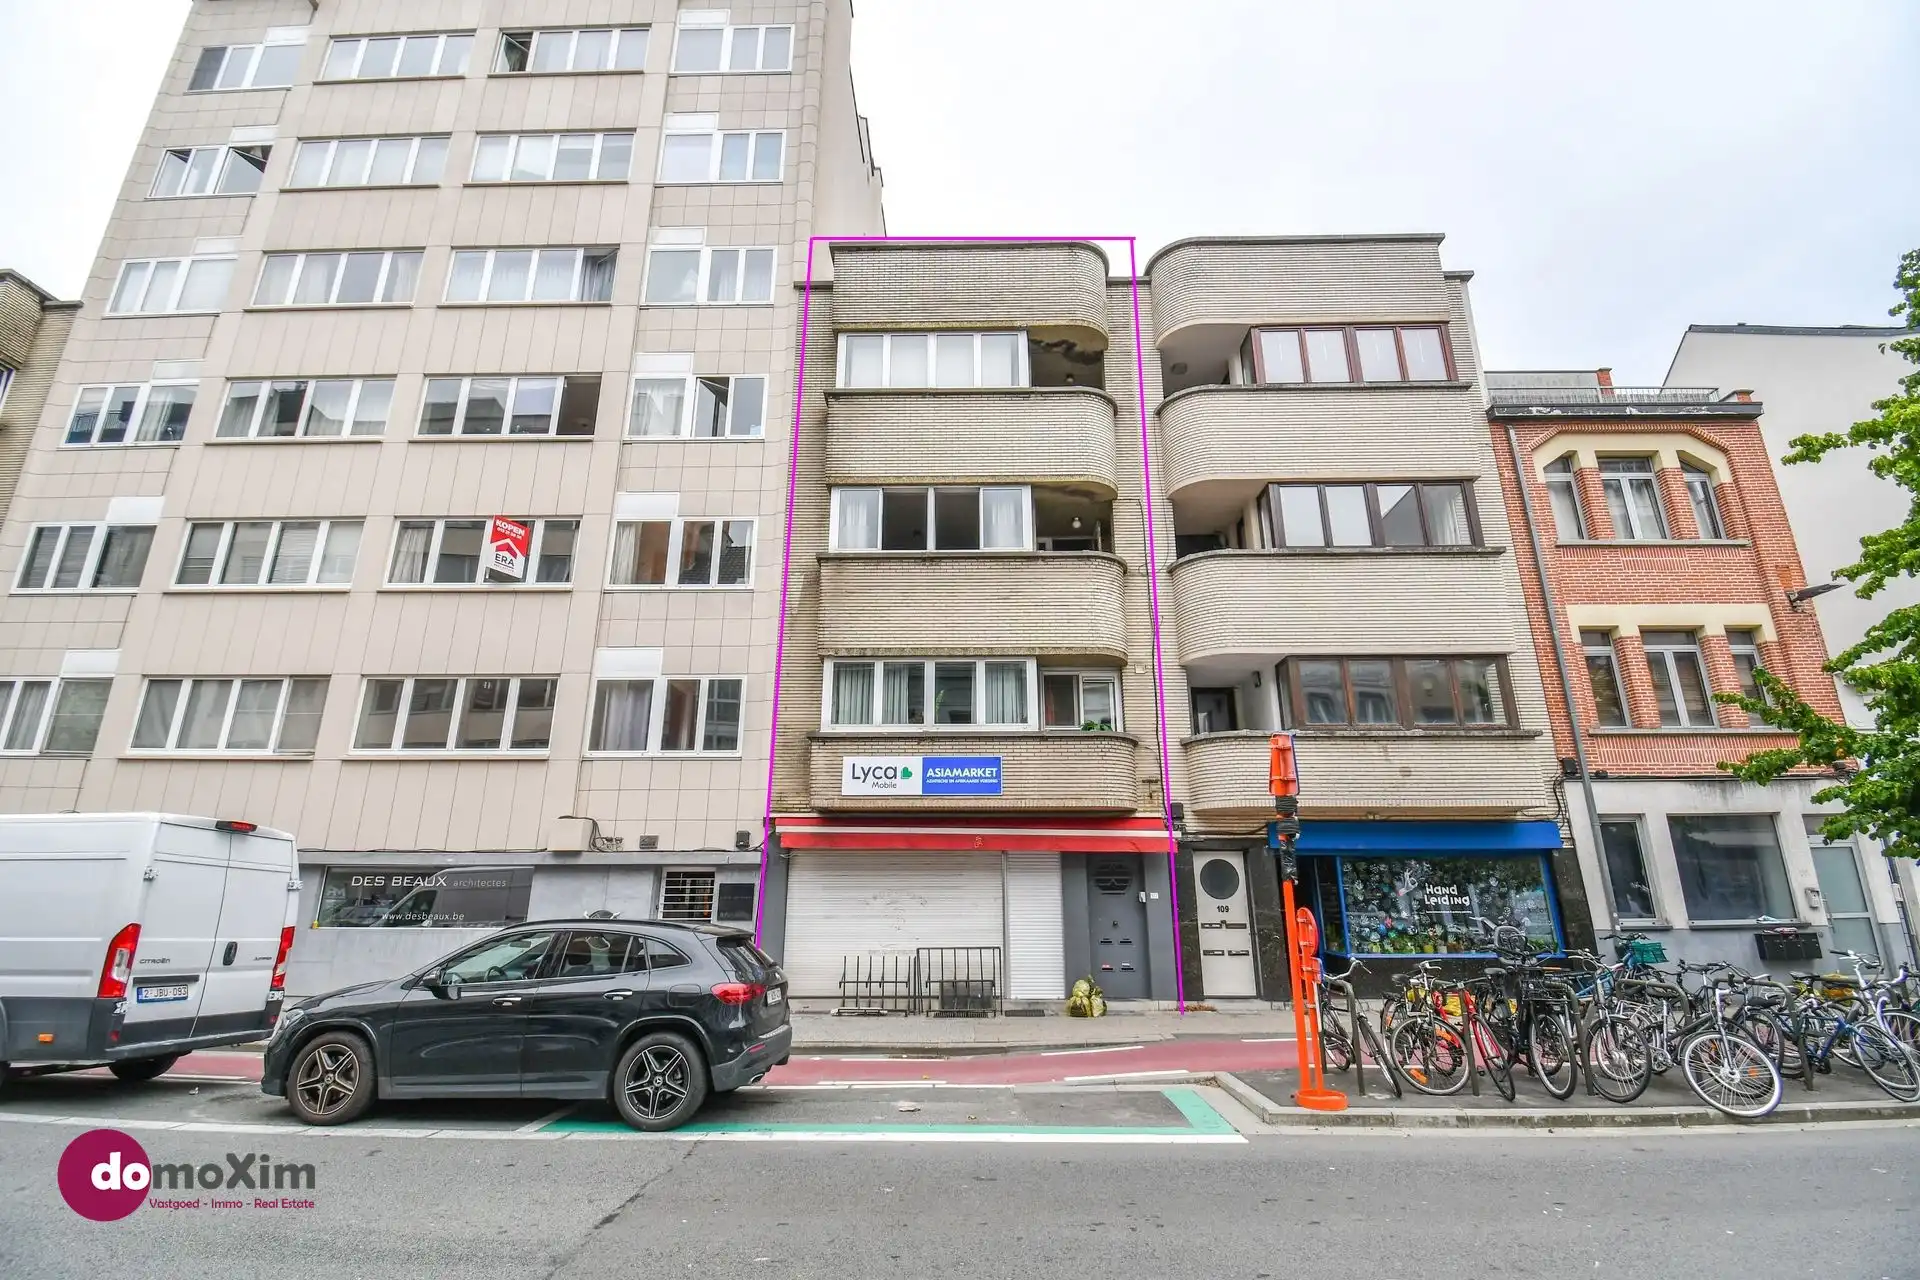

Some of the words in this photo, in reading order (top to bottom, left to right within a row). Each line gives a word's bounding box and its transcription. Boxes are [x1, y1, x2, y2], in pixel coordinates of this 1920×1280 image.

[495, 520, 525, 536] KOPEN
[494, 553, 515, 567] ERA
[851, 763, 897, 783] Lyca
[926, 767, 998, 778] ASIAMARKET
[871, 781, 897, 789] Mobile
[351, 875, 385, 887] DES
[391, 875, 448, 887] BEAUX
[453, 879, 507, 887] architectes
[1216, 905, 1230, 913] 109
[381, 911, 465, 921] www.desbeaux.be
